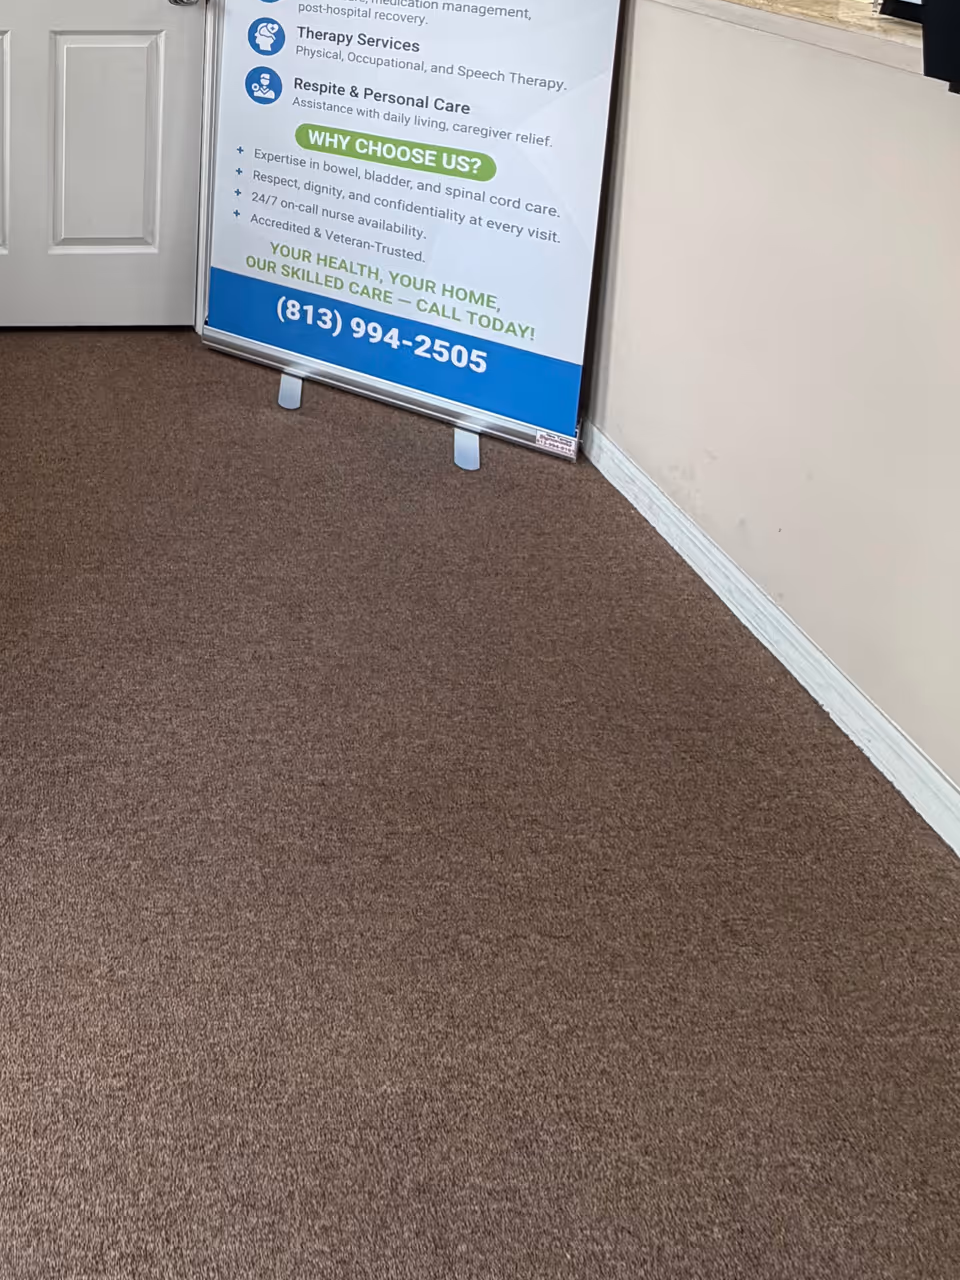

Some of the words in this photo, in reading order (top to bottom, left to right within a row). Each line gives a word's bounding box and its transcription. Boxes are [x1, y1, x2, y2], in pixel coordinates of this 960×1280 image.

[298, 3, 372, 19] post-hospital
[374, 11, 429, 27] recovery.
[441, 2, 532, 21] management,
[296, 25, 354, 47] Therapy
[356, 32, 421, 53] Services
[295, 44, 345, 63] Physical,
[347, 51, 428, 74] Occupational,
[430, 63, 455, 75] and
[457, 65, 506, 82] Speech
[509, 71, 567, 93] Therapy.
[293, 76, 346, 97] Respite
[349, 85, 360, 99] &
[363, 87, 430, 109] Personal
[433, 97, 471, 115] Care
[291, 96, 354, 115] Assistance
[355, 107, 381, 120] with
[382, 110, 411, 127] daily
[413, 114, 449, 133] living,
[451, 123, 513, 141] caregiver
[515, 132, 553, 148] relief.
[308, 129, 351, 151] WHY
[355, 137, 438, 167] CHOOSE
[442, 152, 482, 174] US?
[252, 169, 301, 191] Respect,
[303, 179, 346, 200] dignity,
[347, 191, 371, 204] and
[373, 197, 466, 226] confidentiality
[468, 215, 484, 227] at
[485, 219, 525, 238] every
[527, 227, 561, 244] visit.
[253, 147, 307, 168] Expertise
[309, 157, 320, 171] in
[322, 159, 361, 181] bowel,
[363, 168, 413, 191] bladder,
[416, 181, 442, 194] and
[444, 186, 486, 203] spinal
[489, 195, 521, 210] cord
[524, 202, 561, 218] care.
[249, 213, 311, 236] Accredited
[313, 227, 322, 239] &
[324, 229, 426, 263] Veteran-Trusted.
[251, 191, 279, 206] 24/7
[279, 199, 319, 216] on-call
[321, 207, 355, 223] nurse
[357, 216, 427, 241] availability.
[245, 255, 277, 275] OUR
[280, 263, 345, 291] SKILLED
[348, 281, 394, 305] CARE
[415, 298, 462, 323] CALL
[465, 310, 535, 341] TODAY!
[269, 241, 313, 264] YOUR
[316, 252, 384, 285] HEALTH,
[388, 270, 437, 295] YOUR
[441, 283, 501, 313] HOME,
[277, 296, 342, 337] (813)
[350, 317, 487, 373] 994-2505
